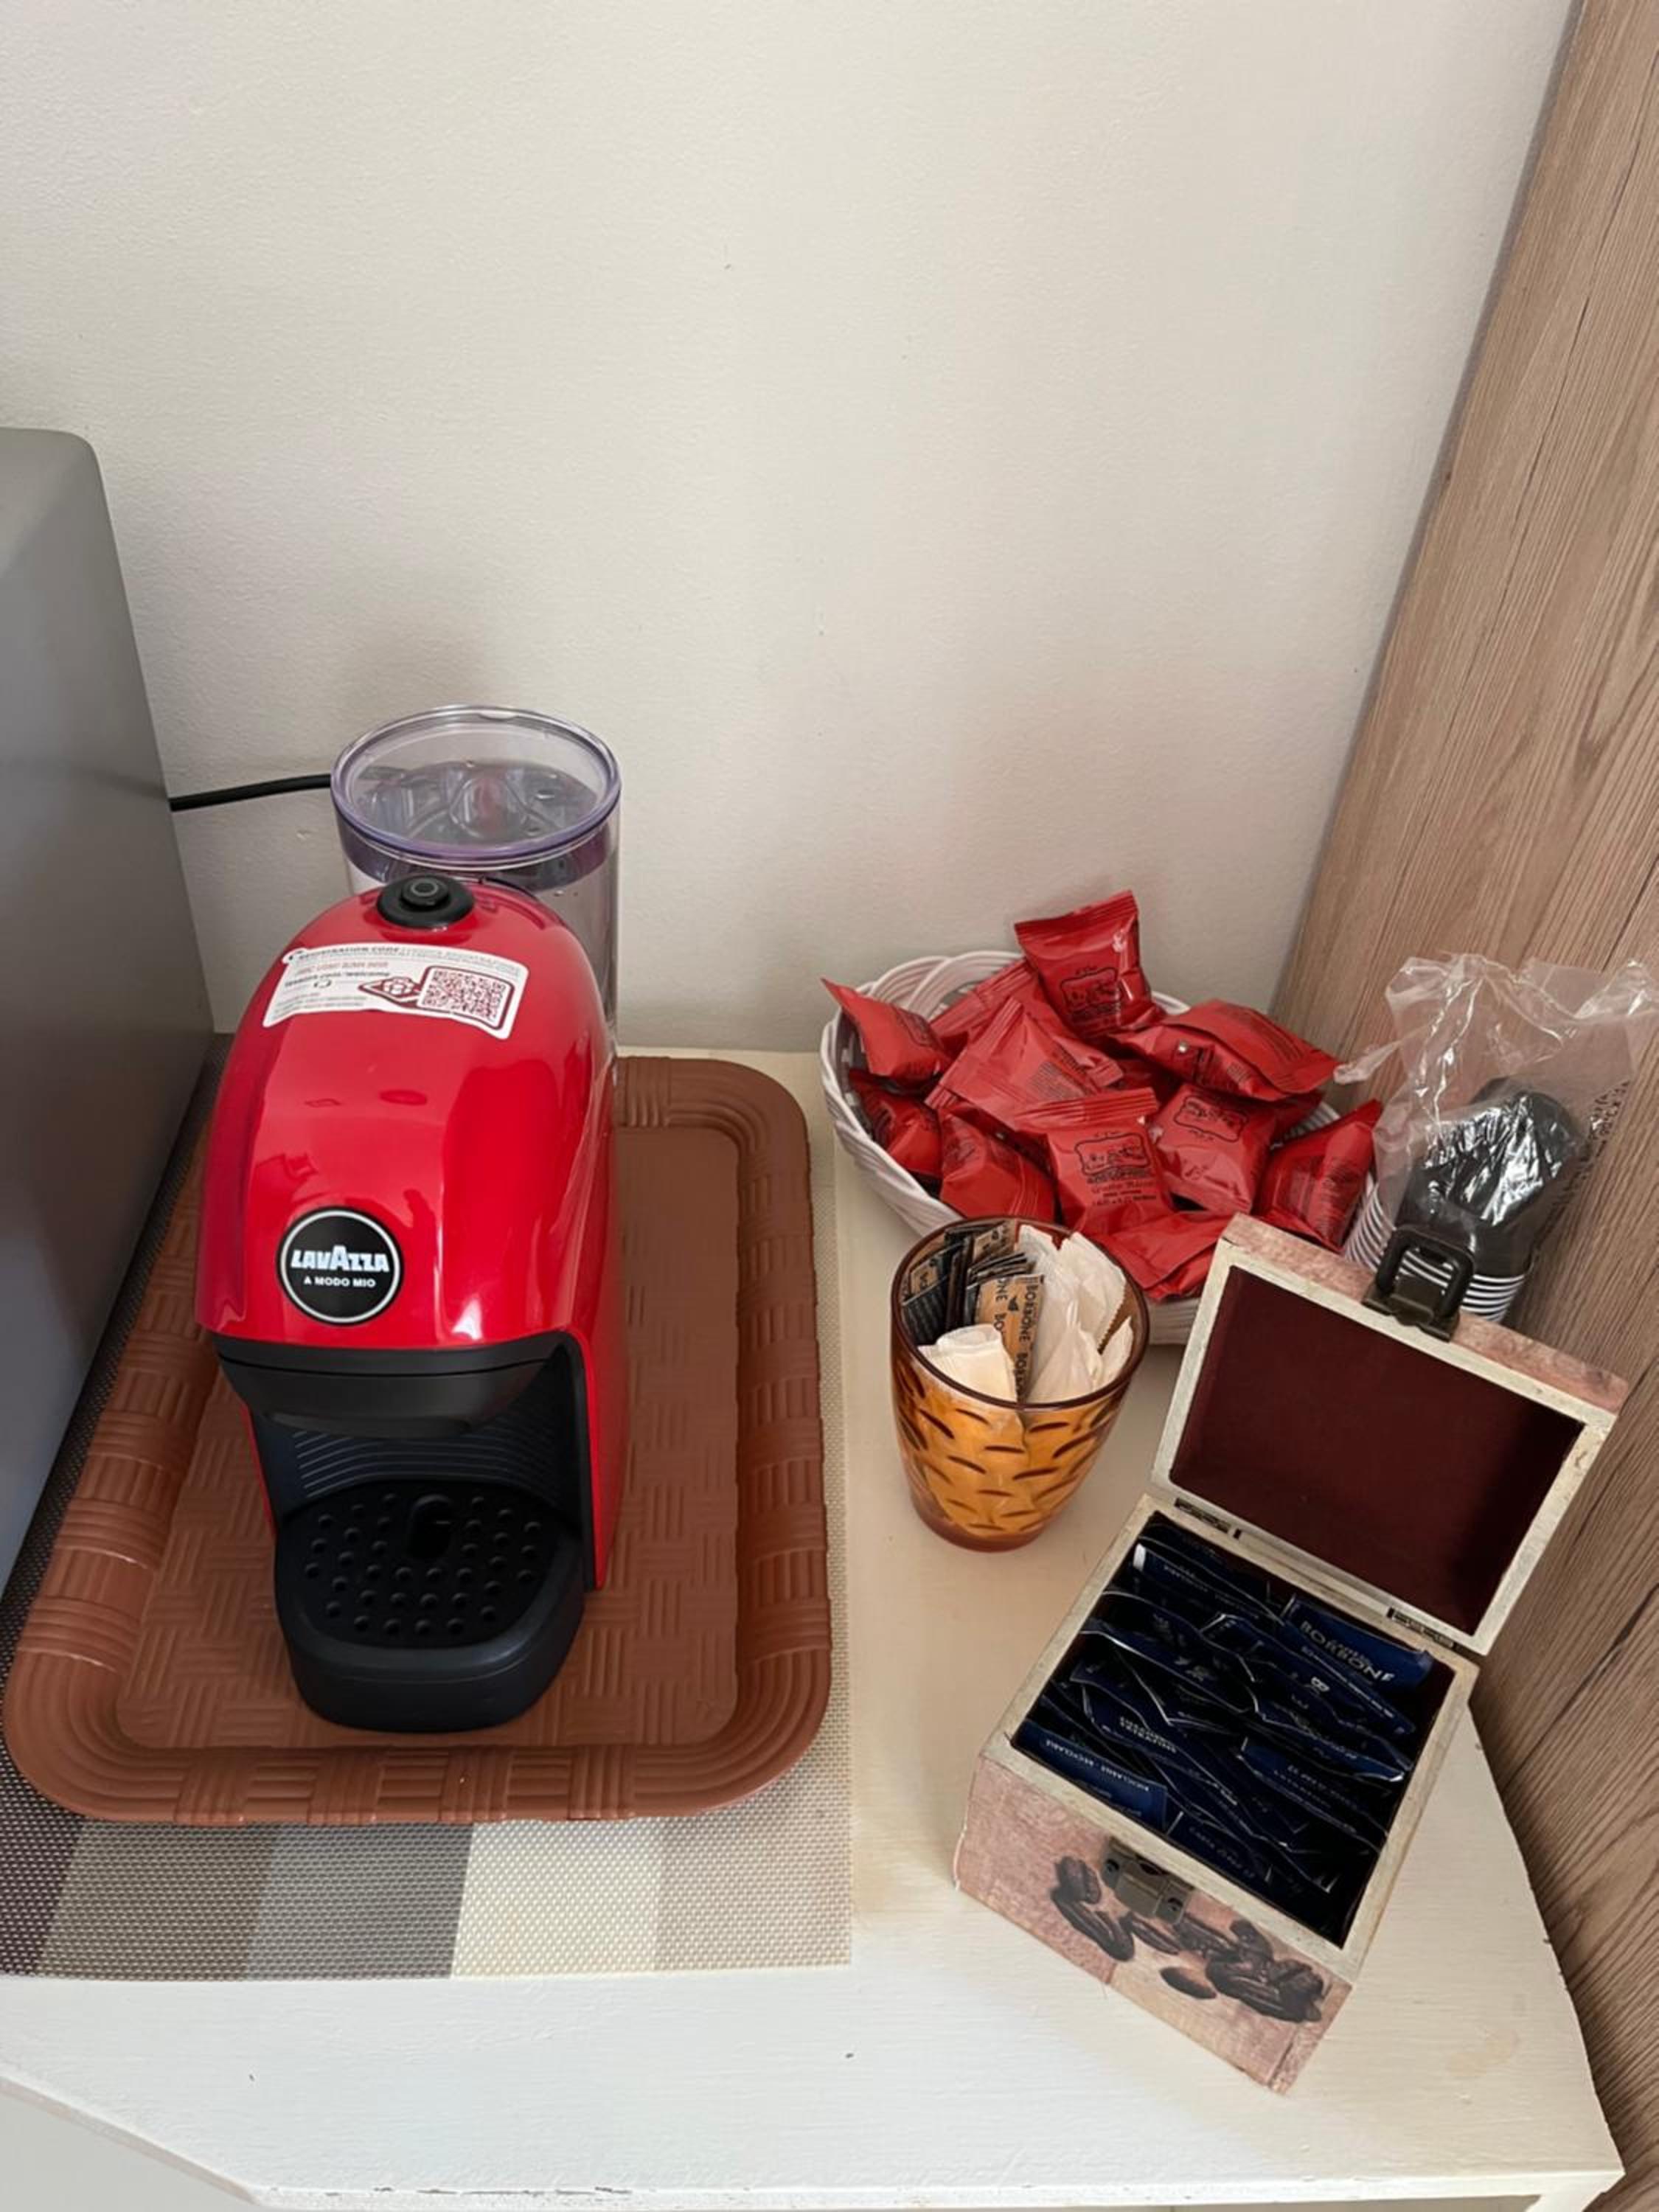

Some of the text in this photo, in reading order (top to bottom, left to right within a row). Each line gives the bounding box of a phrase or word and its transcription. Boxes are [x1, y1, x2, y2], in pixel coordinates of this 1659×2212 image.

[291, 1245, 390, 1272] LAVAZZA
[304, 1276, 376, 1289] A MODO MIO
[1018, 1284, 1039, 1343] BORBONE
